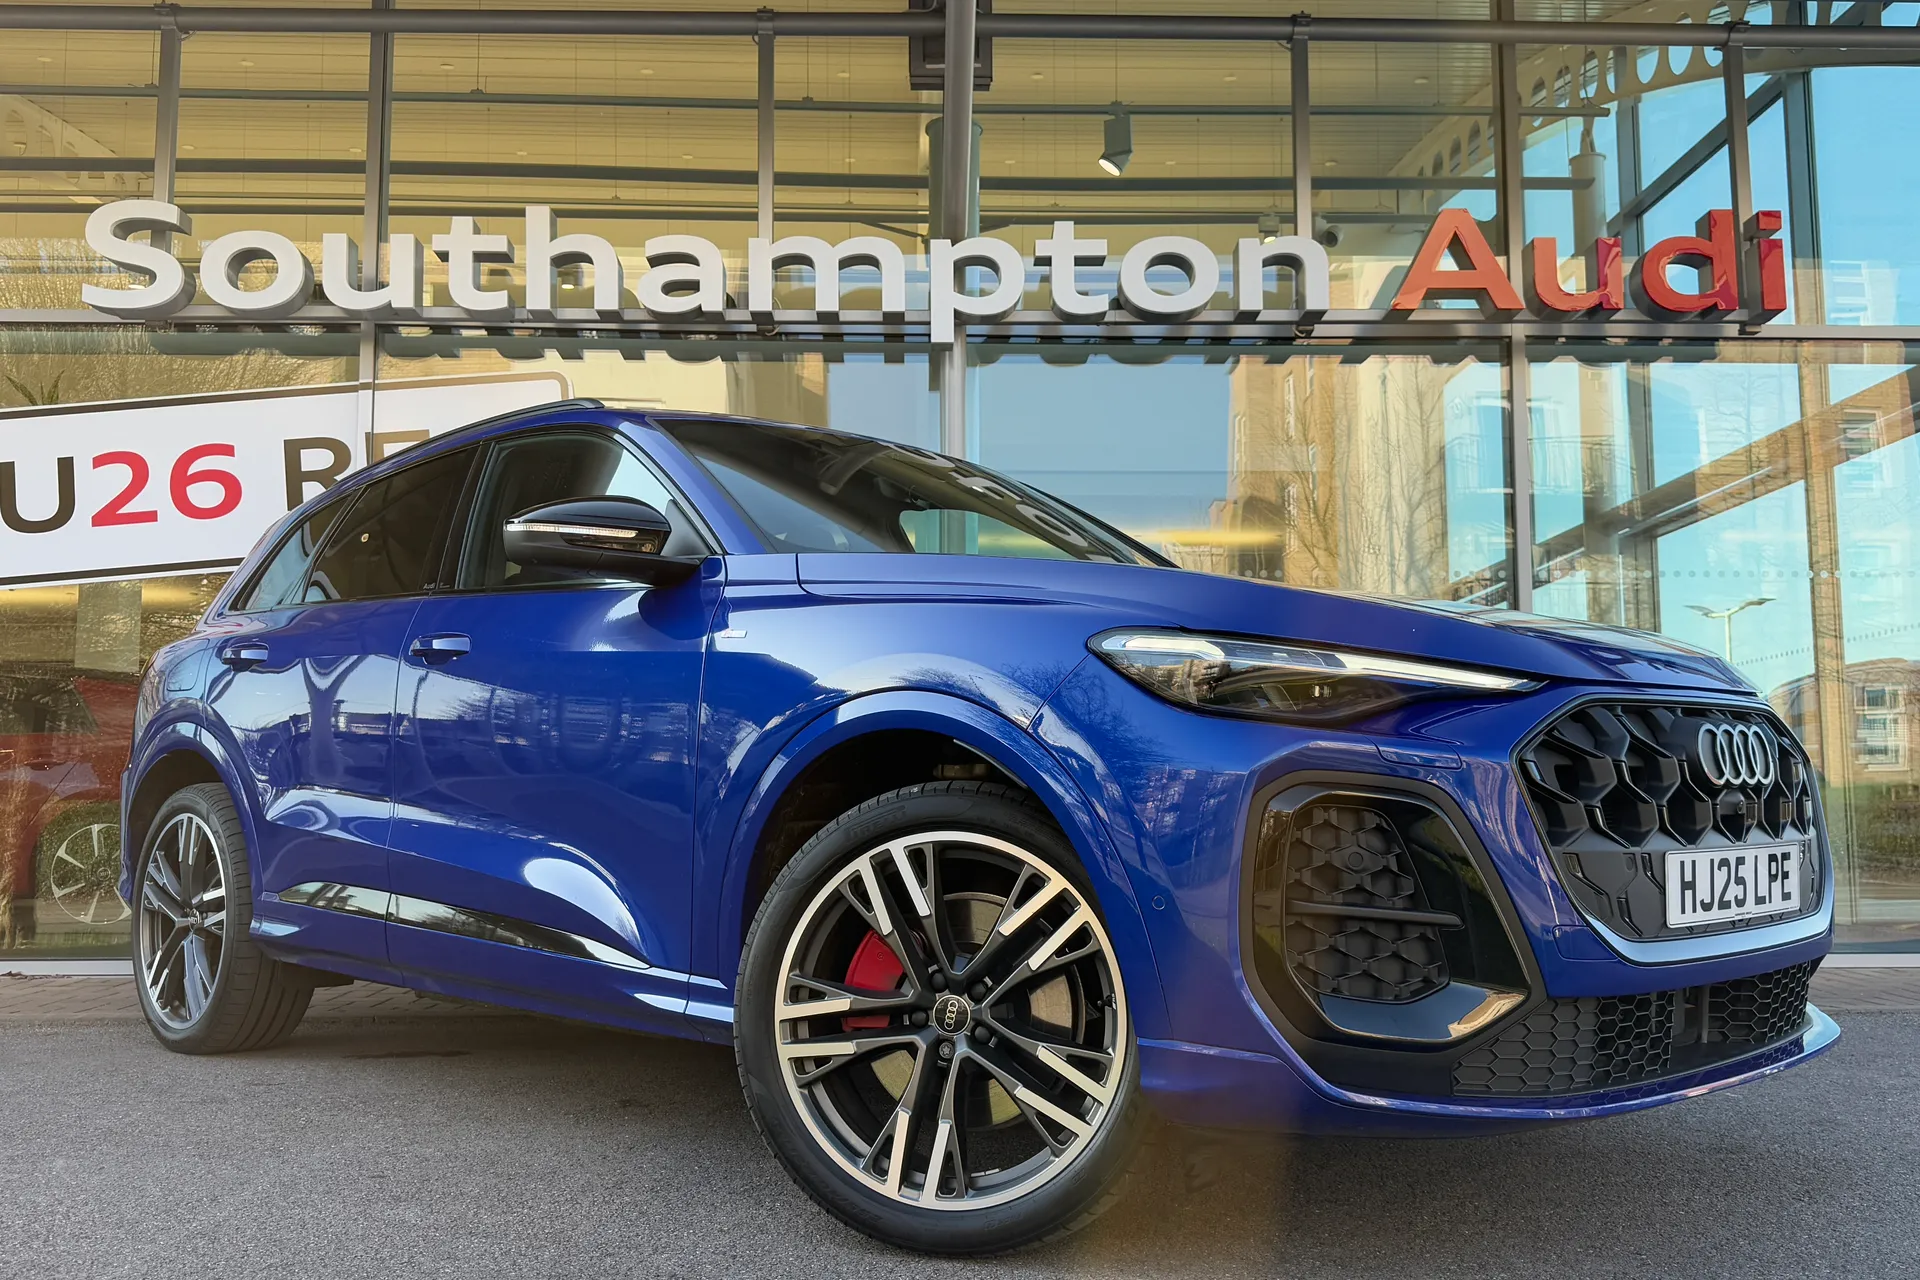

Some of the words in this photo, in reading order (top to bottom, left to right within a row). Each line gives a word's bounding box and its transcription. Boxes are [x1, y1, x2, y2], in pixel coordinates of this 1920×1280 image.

[81, 200, 1330, 345] Southampton
[1391, 208, 1786, 320] Audi
[1679, 856, 1747, 915] HJ25
[1754, 851, 1792, 906] LPE
